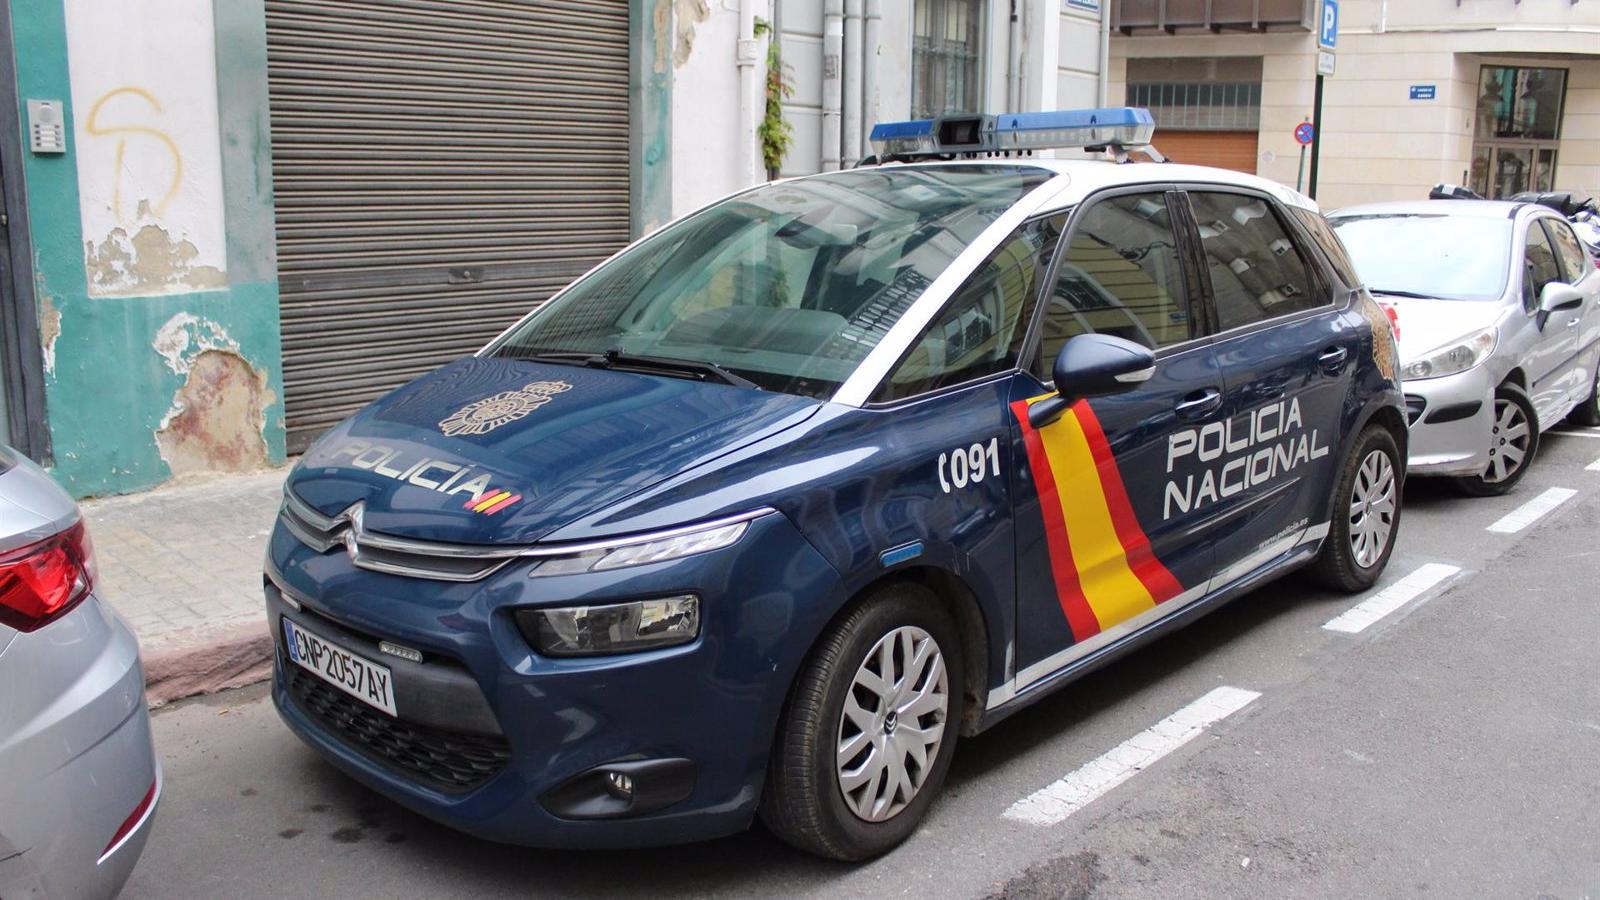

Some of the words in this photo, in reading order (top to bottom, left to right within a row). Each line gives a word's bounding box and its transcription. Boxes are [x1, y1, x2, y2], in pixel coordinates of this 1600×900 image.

[1323, 5, 1335, 39] P
[951, 437, 1000, 489] 091
[1167, 395, 1302, 473] POLICÍA
[331, 441, 491, 500] POLICÍA
[1164, 429, 1329, 520] NACIONAL
